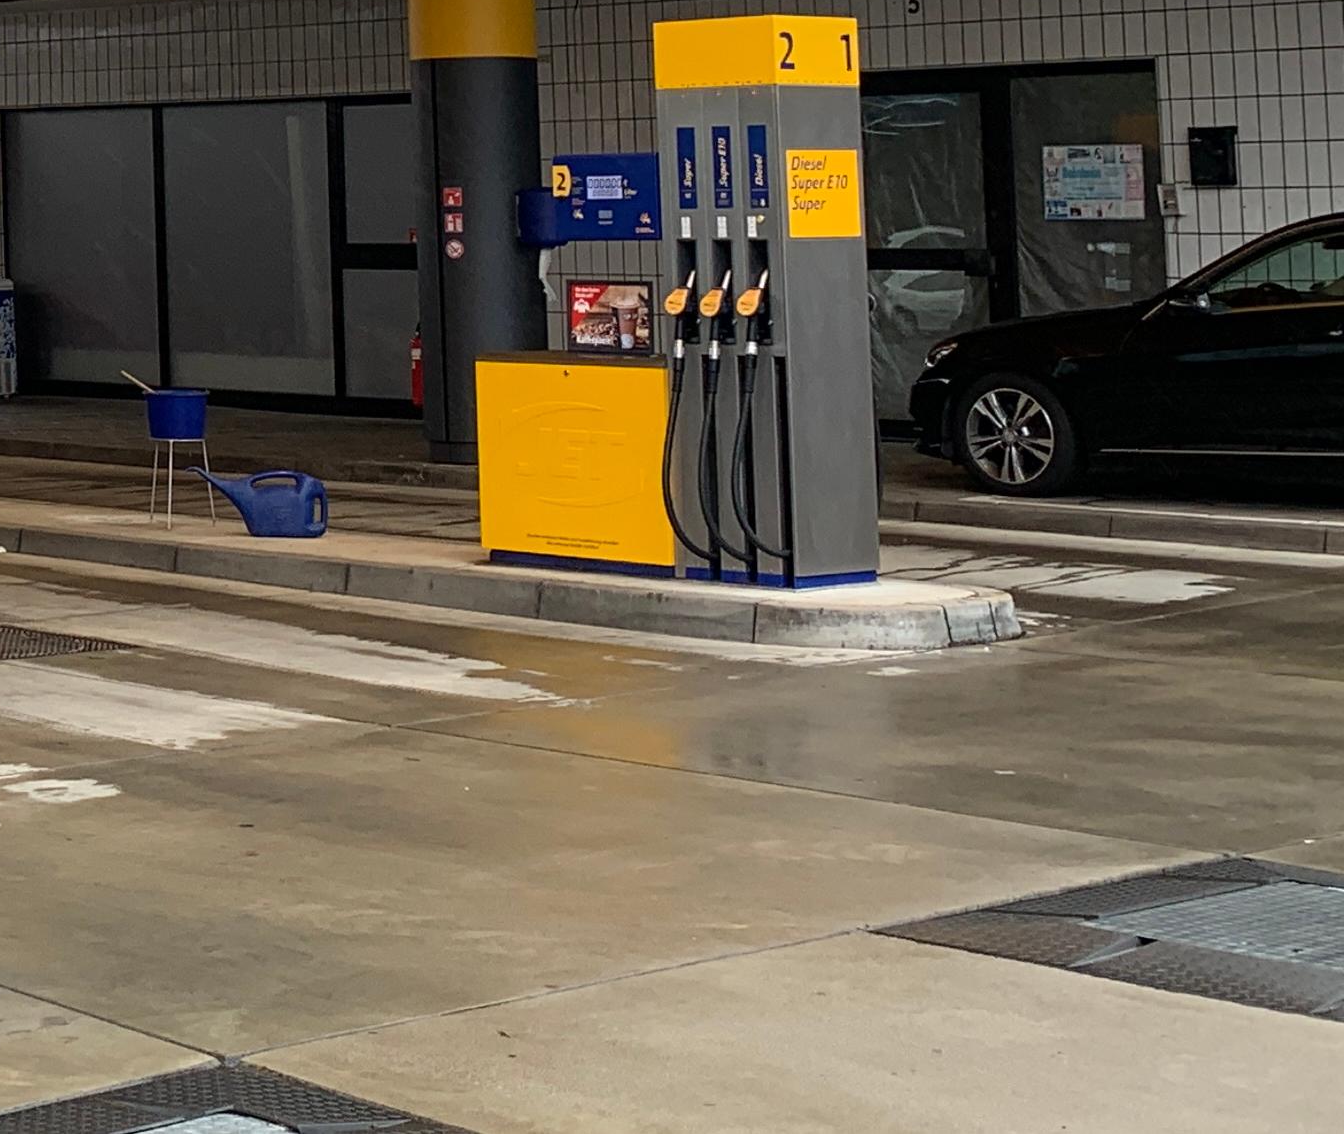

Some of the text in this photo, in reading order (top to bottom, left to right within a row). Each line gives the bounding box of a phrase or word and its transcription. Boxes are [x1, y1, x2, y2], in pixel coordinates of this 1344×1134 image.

[778, 31, 853, 72] 2 1
[683, 157, 694, 188] Super
[719, 156, 730, 188] Super
[754, 153, 764, 186] Diesel
[791, 155, 827, 171] Diesel
[556, 172, 567, 191] 2
[791, 174, 825, 194] Super
[792, 195, 827, 215] Super
